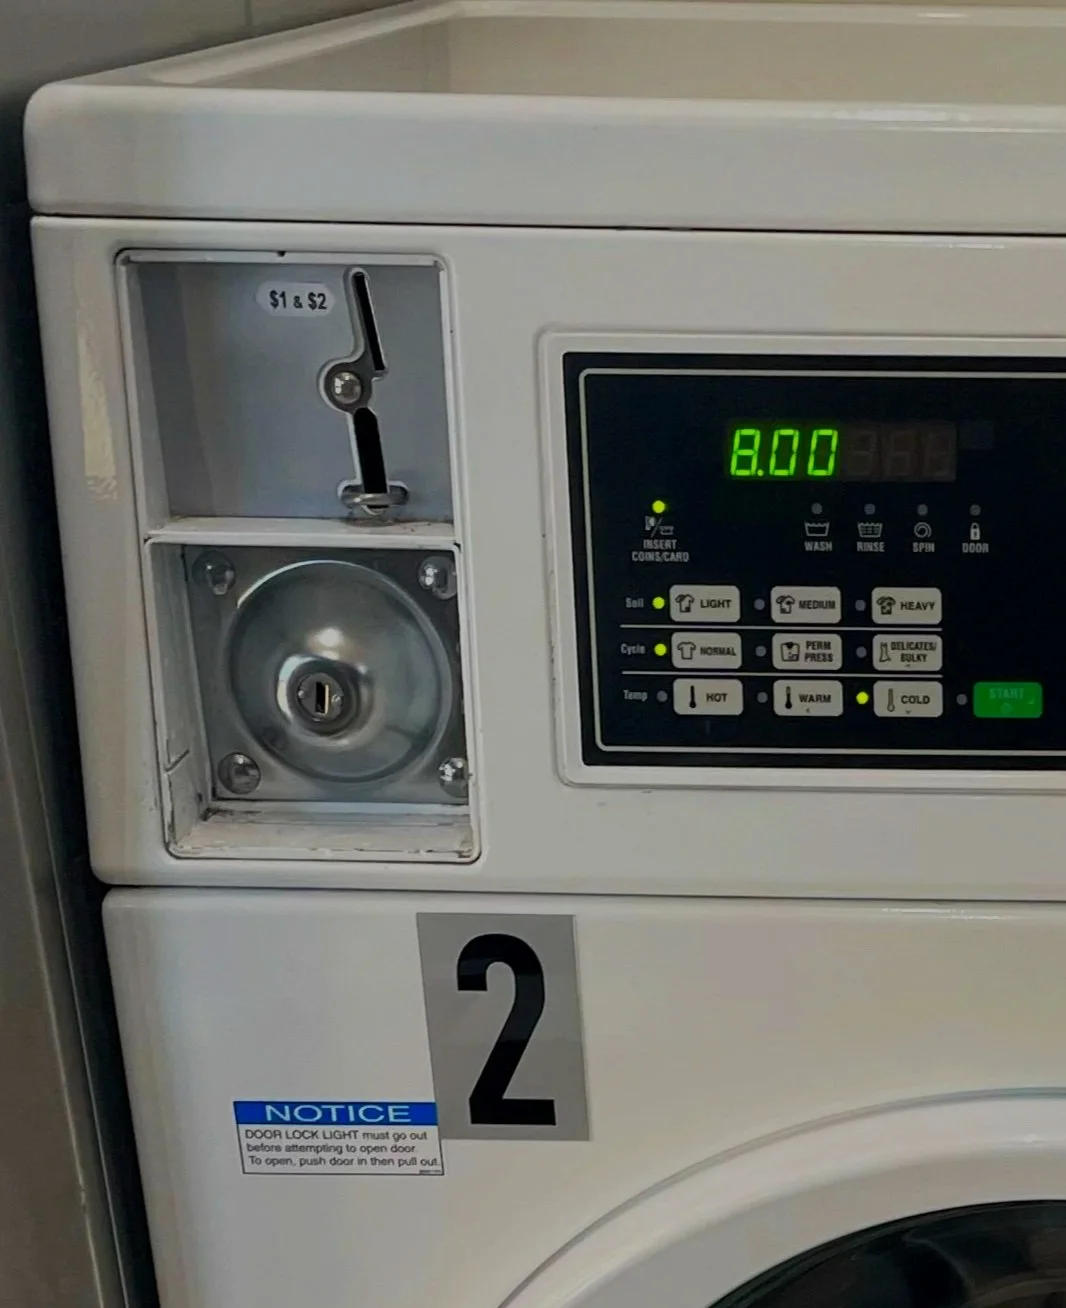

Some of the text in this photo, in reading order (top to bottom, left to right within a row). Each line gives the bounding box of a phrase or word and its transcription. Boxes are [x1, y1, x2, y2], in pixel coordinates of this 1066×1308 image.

[269, 290, 327, 310] $1 & $2
[730, 428, 838, 476] 8.00
[643, 540, 677, 549] INSERT
[804, 542, 832, 551] WASH
[857, 542, 885, 551] RINSE
[913, 543, 935, 552] SPIN
[962, 543, 989, 553] DOOR
[632, 552, 689, 562] COINS/CARD
[626, 598, 644, 608] Soil
[700, 600, 732, 609] LIGHT
[799, 600, 836, 609] MEDIUM
[901, 601, 935, 610] HEAVY
[621, 644, 645, 655] Cycle
[806, 641, 831, 650] PERM
[891, 642, 936, 651] DELICATES/
[700, 647, 736, 656] NORMAL
[805, 653, 833, 662] PRESS
[901, 653, 927, 662] BULKY
[624, 690, 647, 701] Temp
[706, 693, 728, 702] HOT
[989, 688, 1024, 698] START
[799, 694, 831, 703] WARM
[901, 695, 930, 704] COLD
[456, 933, 556, 1126] 2
[265, 1105, 411, 1122] NOTICE
[245, 1130, 427, 1142] DOOR LOCK LIGHT must go out
[247, 1143, 282, 1153] before
[285, 1144, 342, 1155] attempting
[346, 1144, 356, 1153] to
[360, 1145, 388, 1155] open
[249, 1156, 261, 1165] To
[265, 1158, 295, 1167] open,
[299, 1156, 326, 1168] push
[329, 1157, 354, 1166] door
[357, 1157, 367, 1166] in
[370, 1157, 394, 1166] then
[398, 1157, 417, 1167] pull
